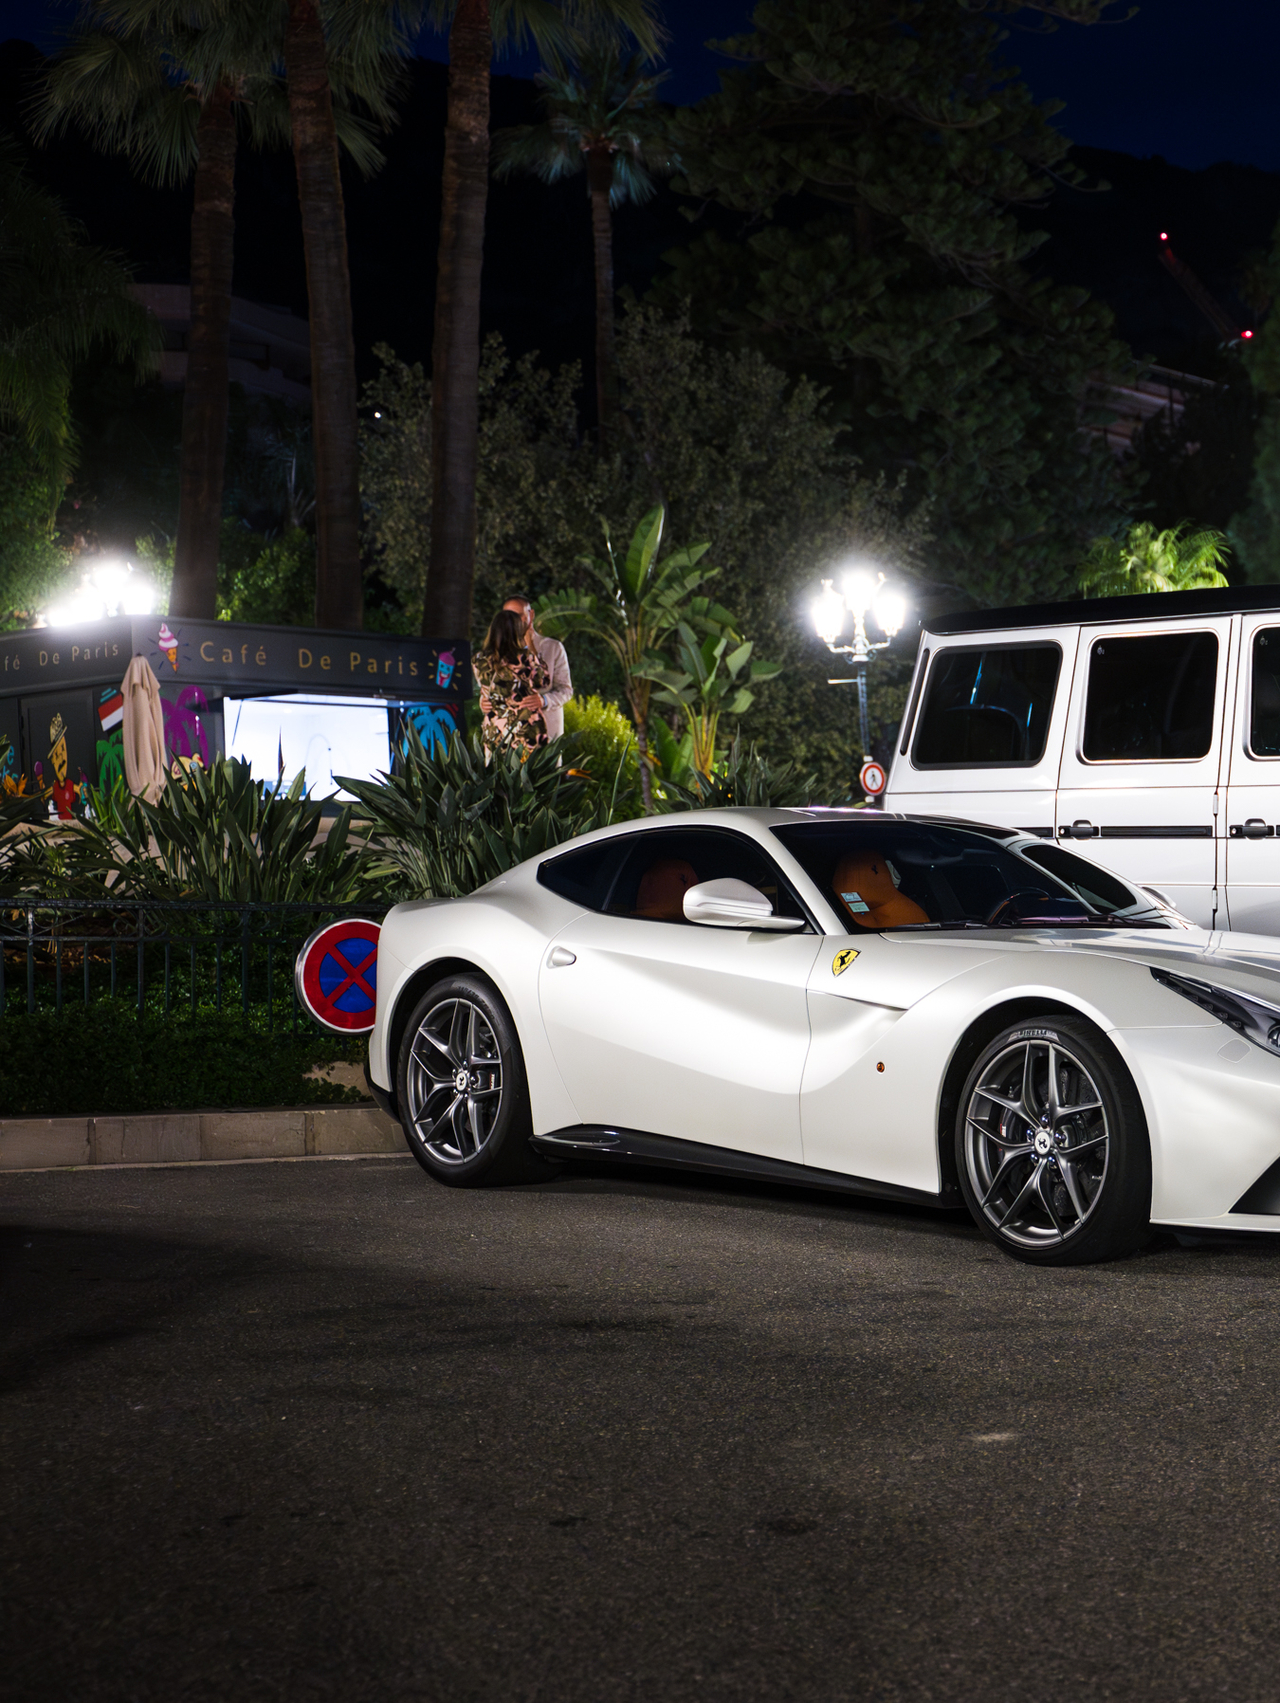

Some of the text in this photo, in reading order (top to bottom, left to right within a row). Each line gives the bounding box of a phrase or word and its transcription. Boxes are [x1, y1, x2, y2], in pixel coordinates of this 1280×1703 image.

[39, 650, 60, 666] De
[71, 641, 119, 662] Paris
[200, 641, 418, 676] Café De Paris
